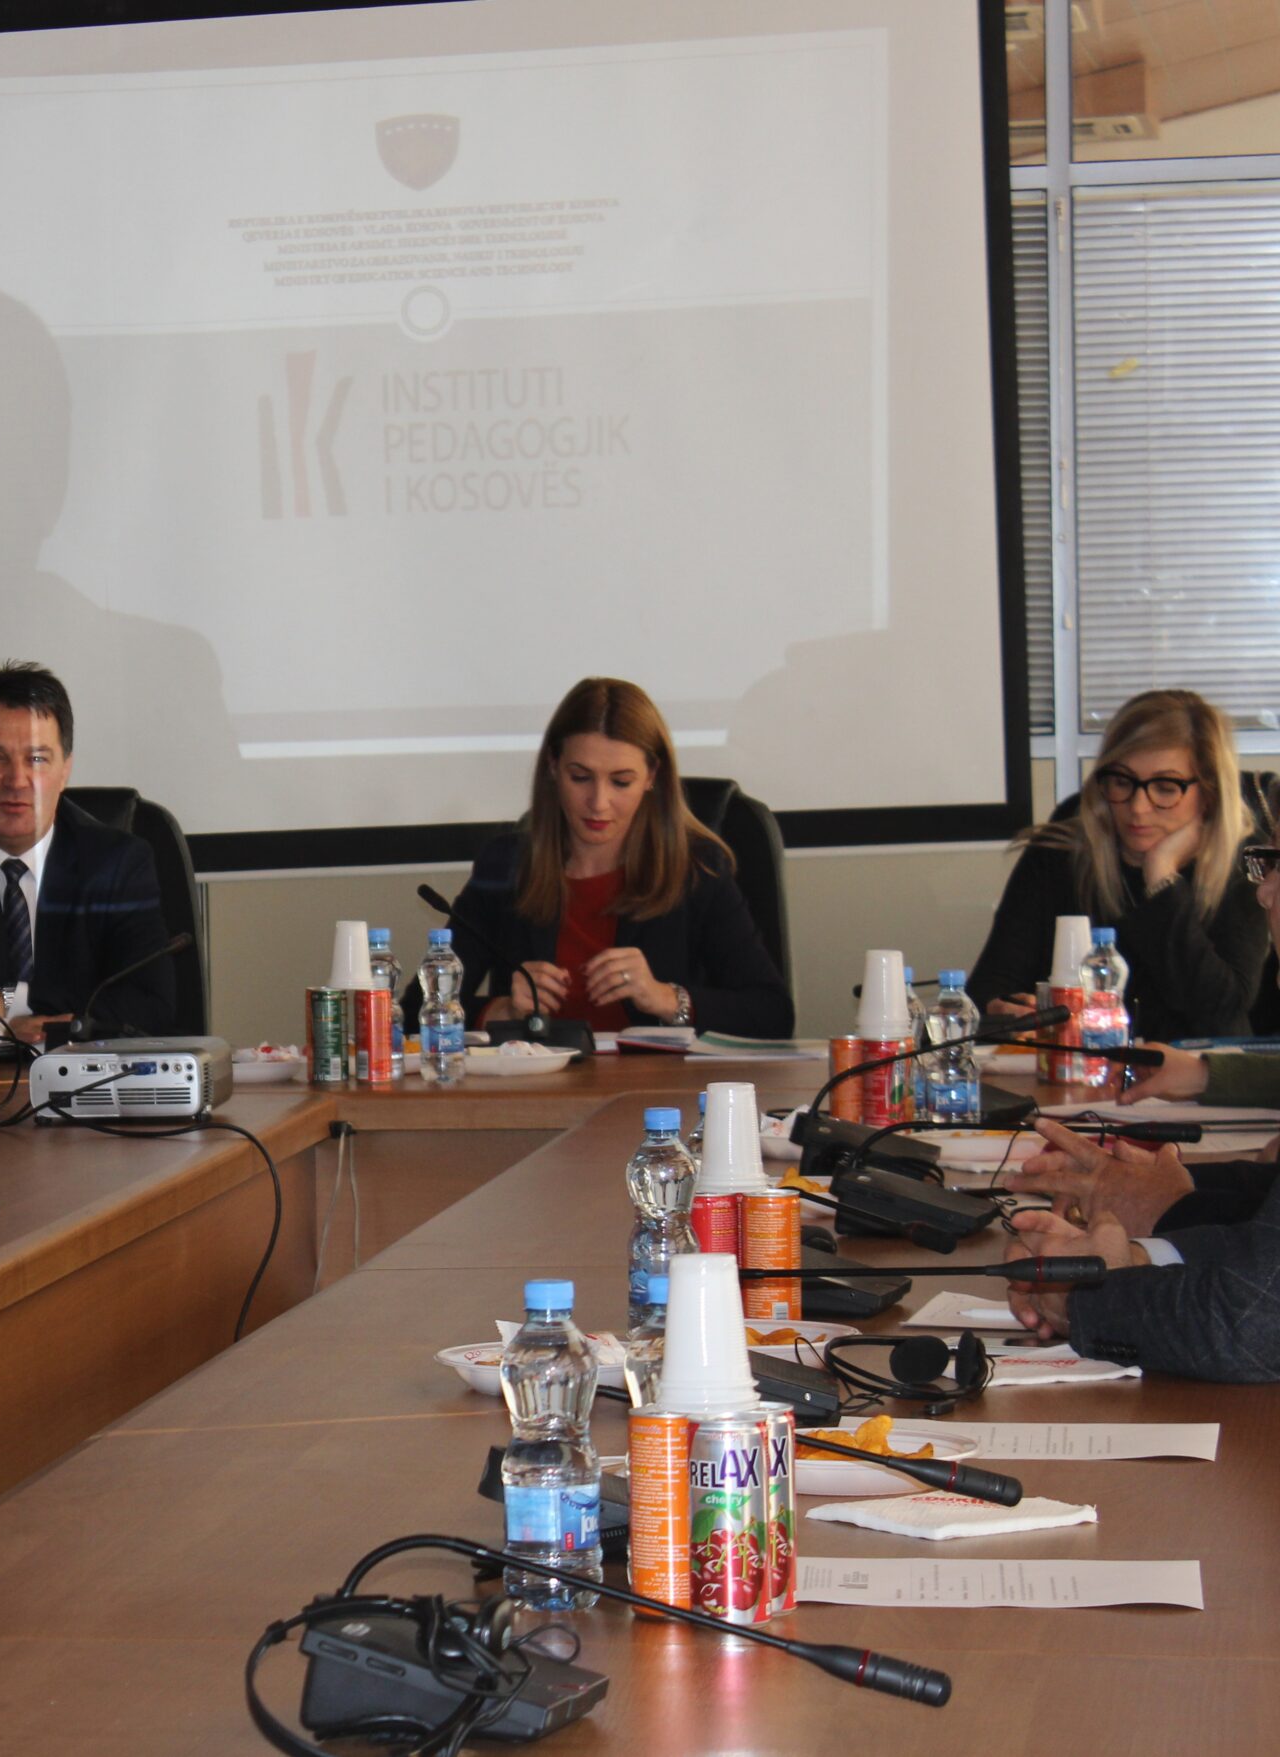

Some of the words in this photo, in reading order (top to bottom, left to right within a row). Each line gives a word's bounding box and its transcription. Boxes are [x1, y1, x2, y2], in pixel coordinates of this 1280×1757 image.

[381, 367, 564, 413] INSTITUTI
[383, 413, 633, 464] PEDAGOGJIK
[384, 475, 394, 515] I
[405, 460, 584, 513] KOSOVËS
[689, 1447, 759, 1489] RELAX
